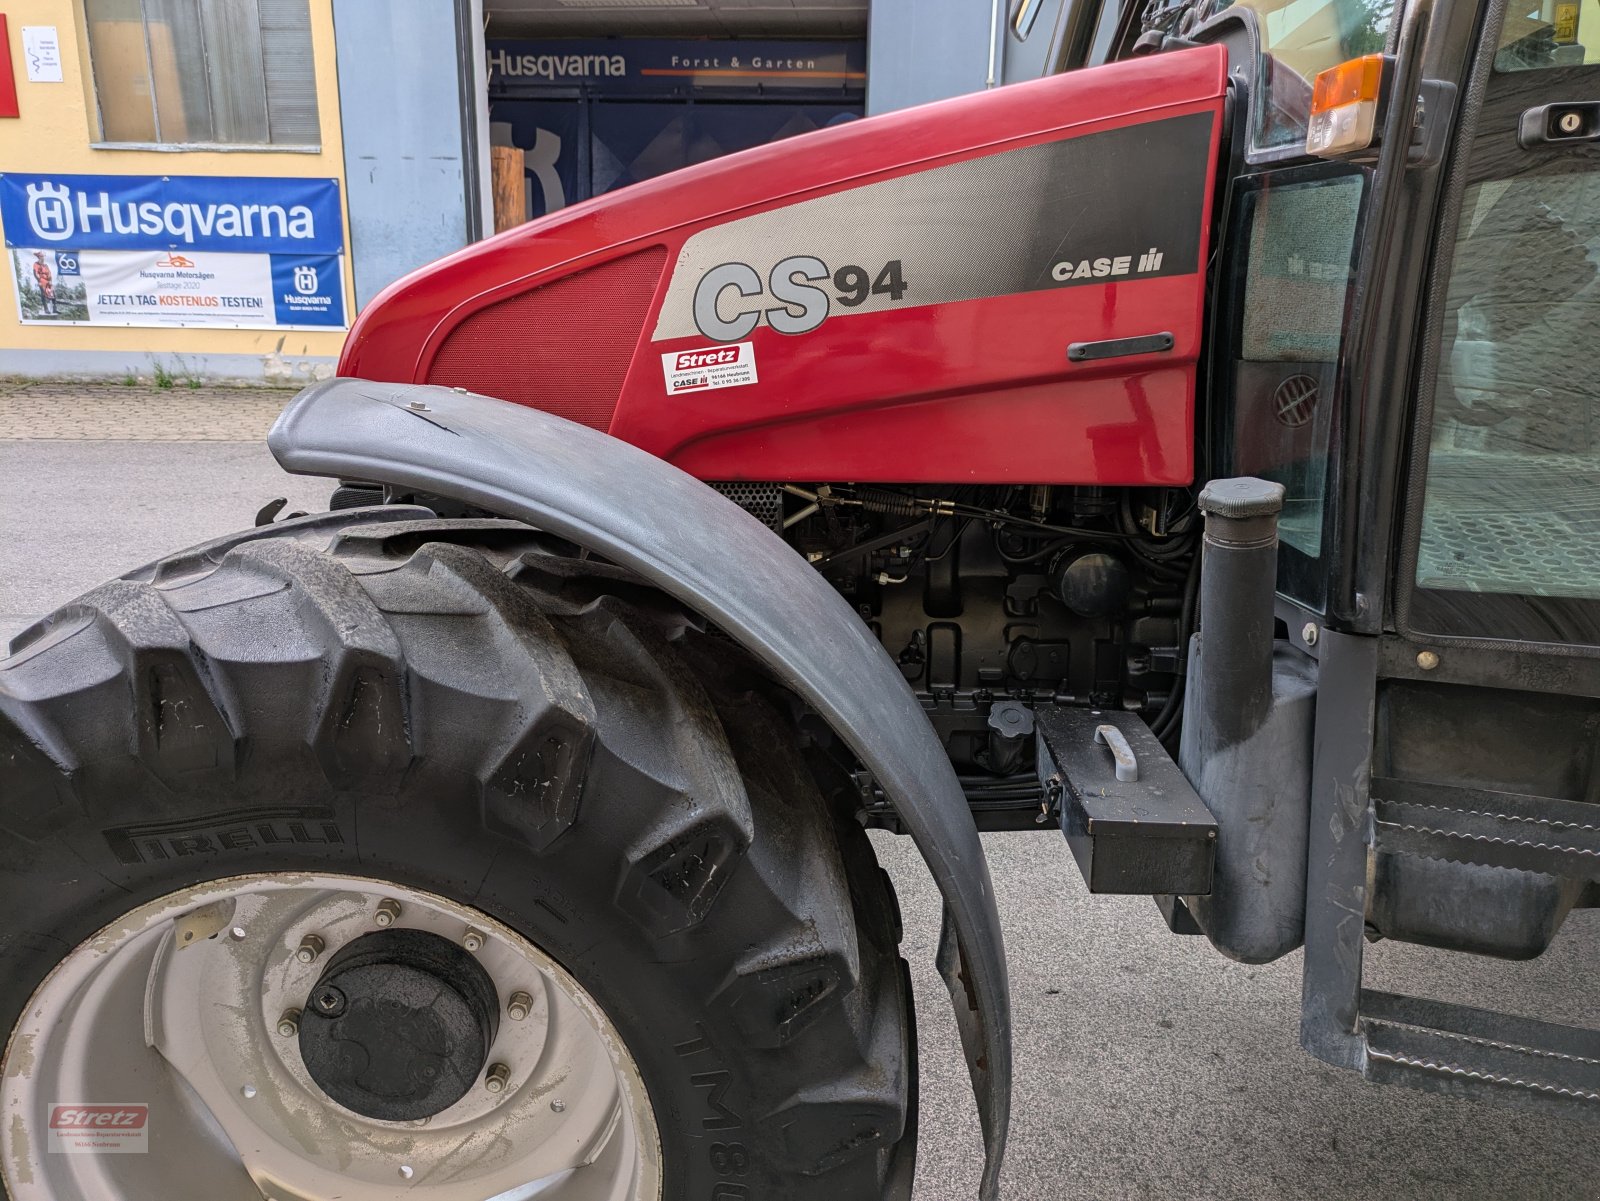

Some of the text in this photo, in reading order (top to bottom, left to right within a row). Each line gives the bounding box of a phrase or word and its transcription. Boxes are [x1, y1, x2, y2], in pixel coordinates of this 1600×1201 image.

[487, 50, 815, 80] Husqvarna Forst & Garten
[77, 191, 315, 243] Husqvarna
[140, 271, 215, 280] Husqvarna Motorsägen
[1051, 255, 1132, 282] CASE
[156, 281, 200, 290] Testtage 2020
[833, 259, 908, 308] 94
[97, 294, 263, 308] JETZT 1 TAG KOSTENLOS TESTEN!
[284, 294, 332, 305] Husqvarna
[678, 349, 736, 368] Stretz
[673, 378, 699, 388] CASE
[102, 805, 344, 866] PIRELLI
